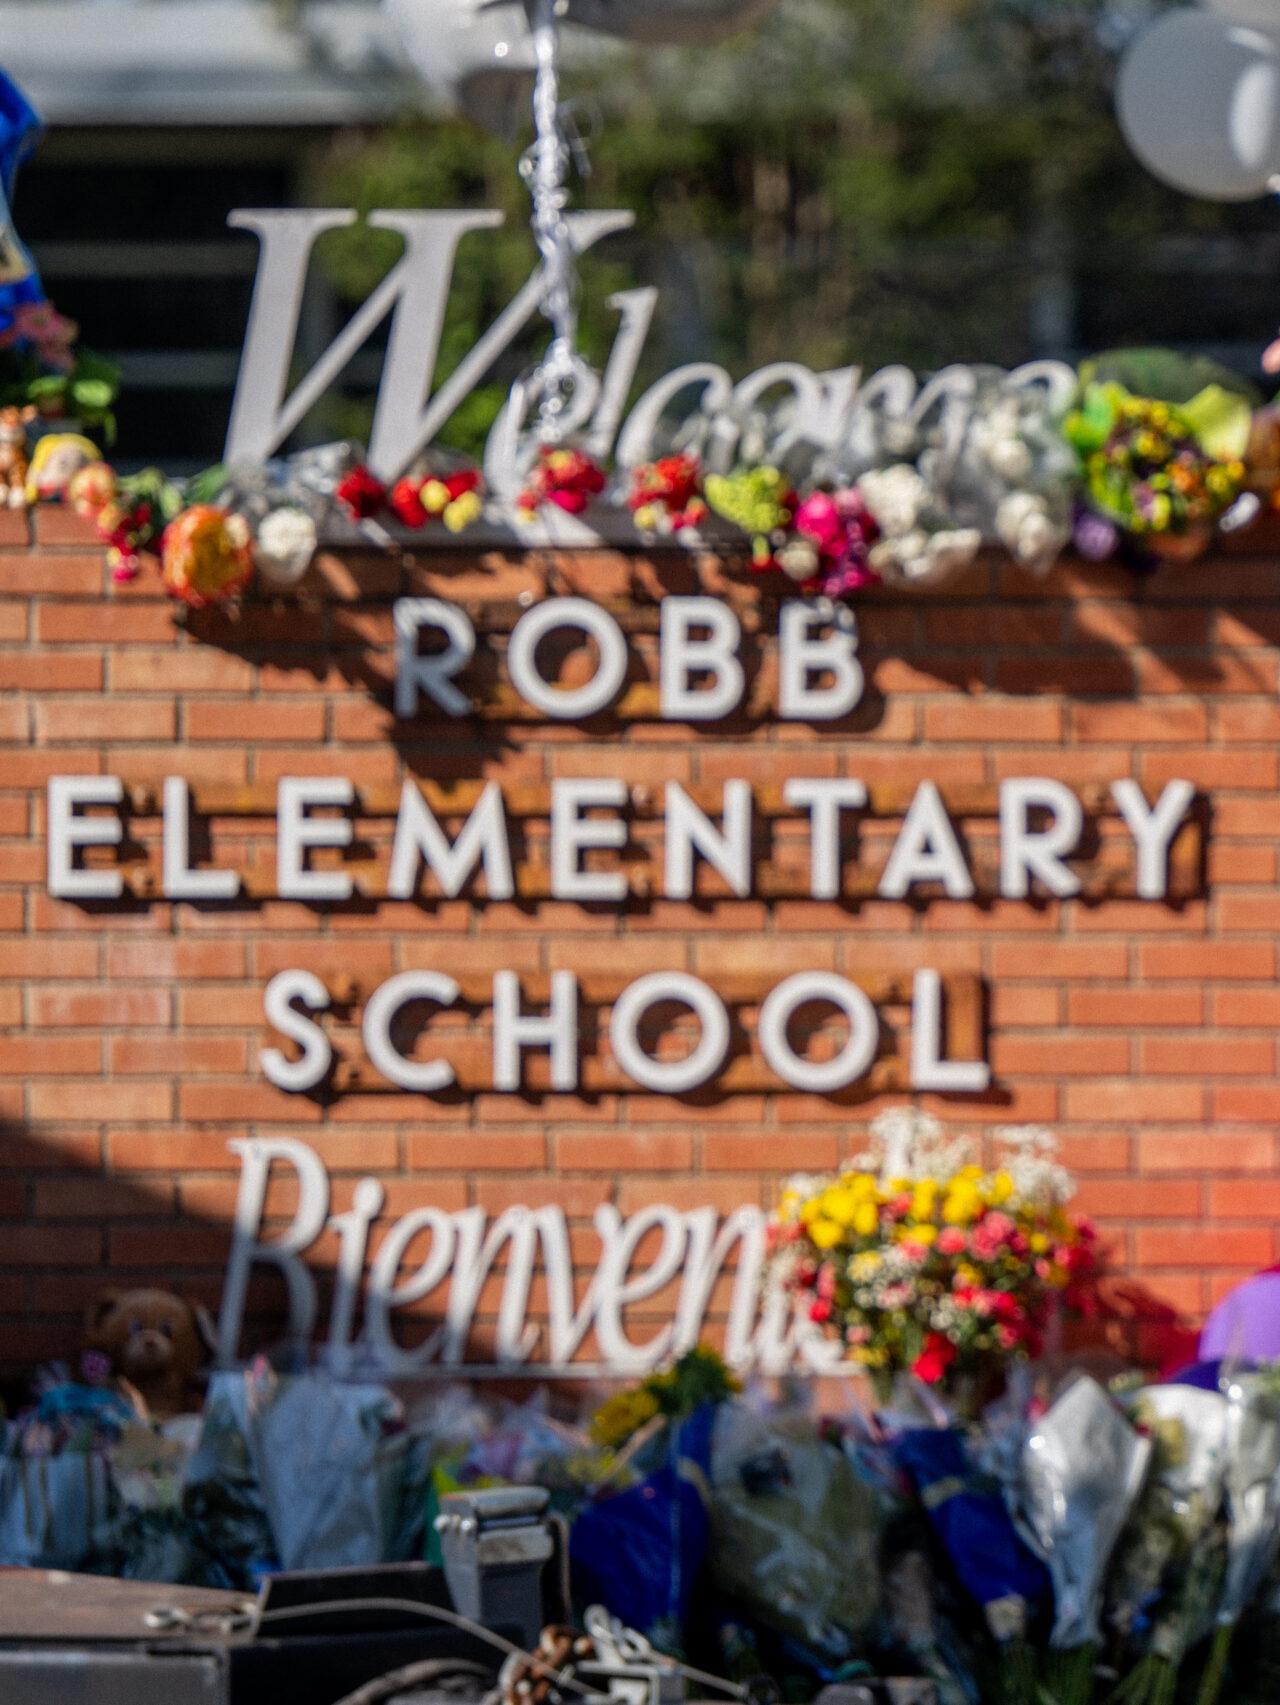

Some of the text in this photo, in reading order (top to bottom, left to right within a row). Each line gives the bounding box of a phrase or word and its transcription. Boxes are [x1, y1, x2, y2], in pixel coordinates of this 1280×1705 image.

[393, 596, 866, 720] ROBB
[47, 774, 1195, 900] ELEMENTARY
[260, 968, 989, 1092] SCHOOL
